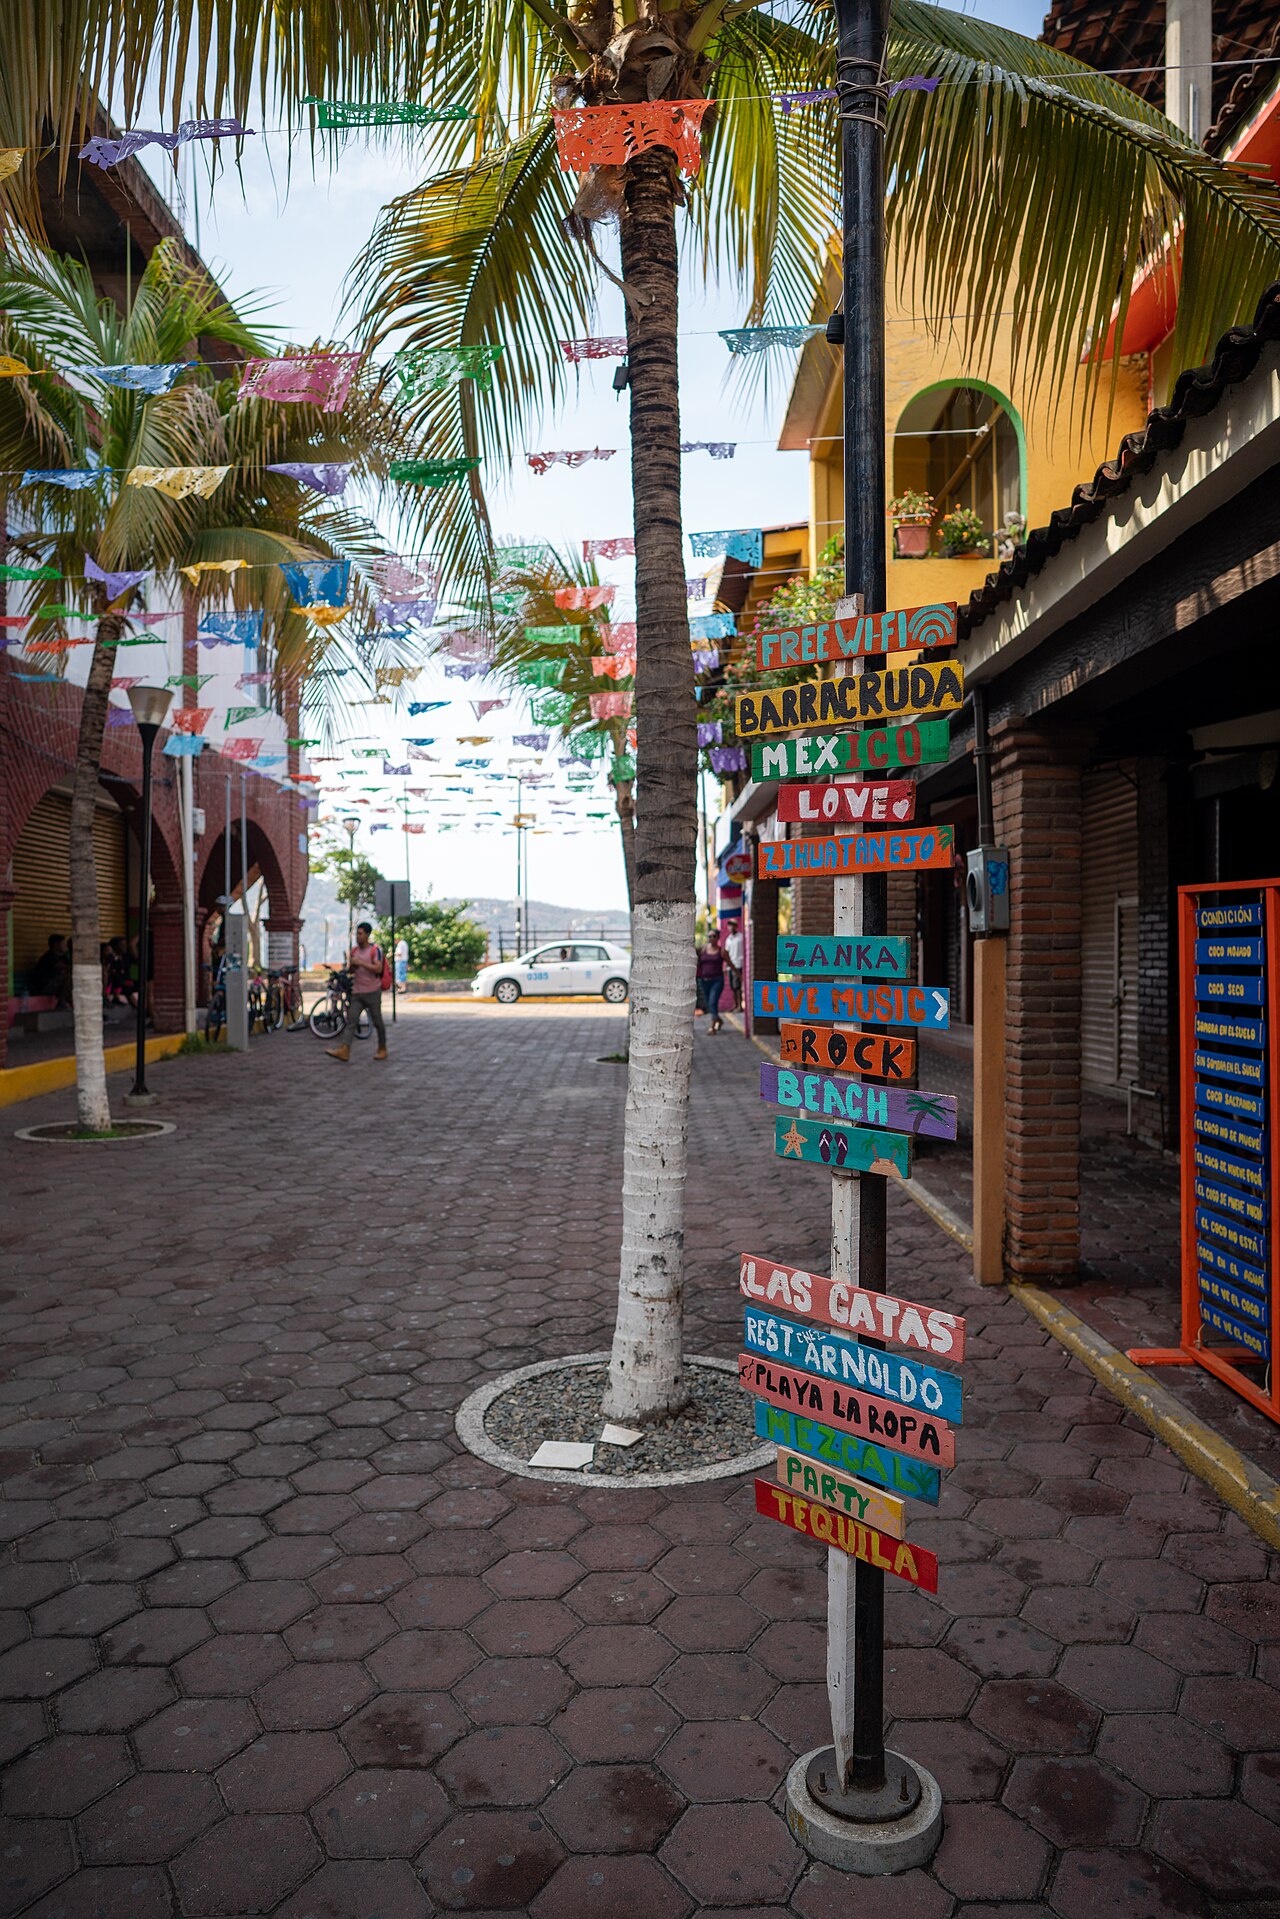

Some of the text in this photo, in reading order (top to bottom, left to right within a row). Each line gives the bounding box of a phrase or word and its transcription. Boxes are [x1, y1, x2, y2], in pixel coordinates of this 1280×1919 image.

[761, 611, 907, 667] FREE WI-FI
[739, 666, 962, 733] BARRACRUDA
[762, 724, 922, 777] MEXICO
[798, 787, 889, 820] LOVE
[763, 833, 935, 872] ZIHUATANEJO
[1201, 905, 1252, 926] CONDICIÓN
[785, 942, 899, 971] ZANKA
[1208, 945, 1225, 958] COCO
[761, 985, 927, 1023] LIVE MUSIC
[1208, 982, 1245, 997] COCO SECO
[1235, 1025, 1256, 1041] SUELO
[801, 1029, 904, 1078] ROCK
[777, 1070, 889, 1126] BEACH
[1206, 1089, 1223, 1104] COCO
[1203, 1120, 1219, 1136] COCO
[1210, 1220, 1228, 1238] COCO
[1199, 1245, 1214, 1263] COCO
[746, 1261, 957, 1354] LAS GATAS
[1241, 1298, 1260, 1319] COCO
[1243, 1331, 1262, 1352] COCO
[804, 1342, 943, 1411] ARNOLDO
[755, 1363, 941, 1456] PLAYA LA ROPA
[766, 1407, 918, 1492] MEZCAL
[786, 1456, 871, 1519] PARTY
[771, 1488, 919, 1582] TEQUILA
